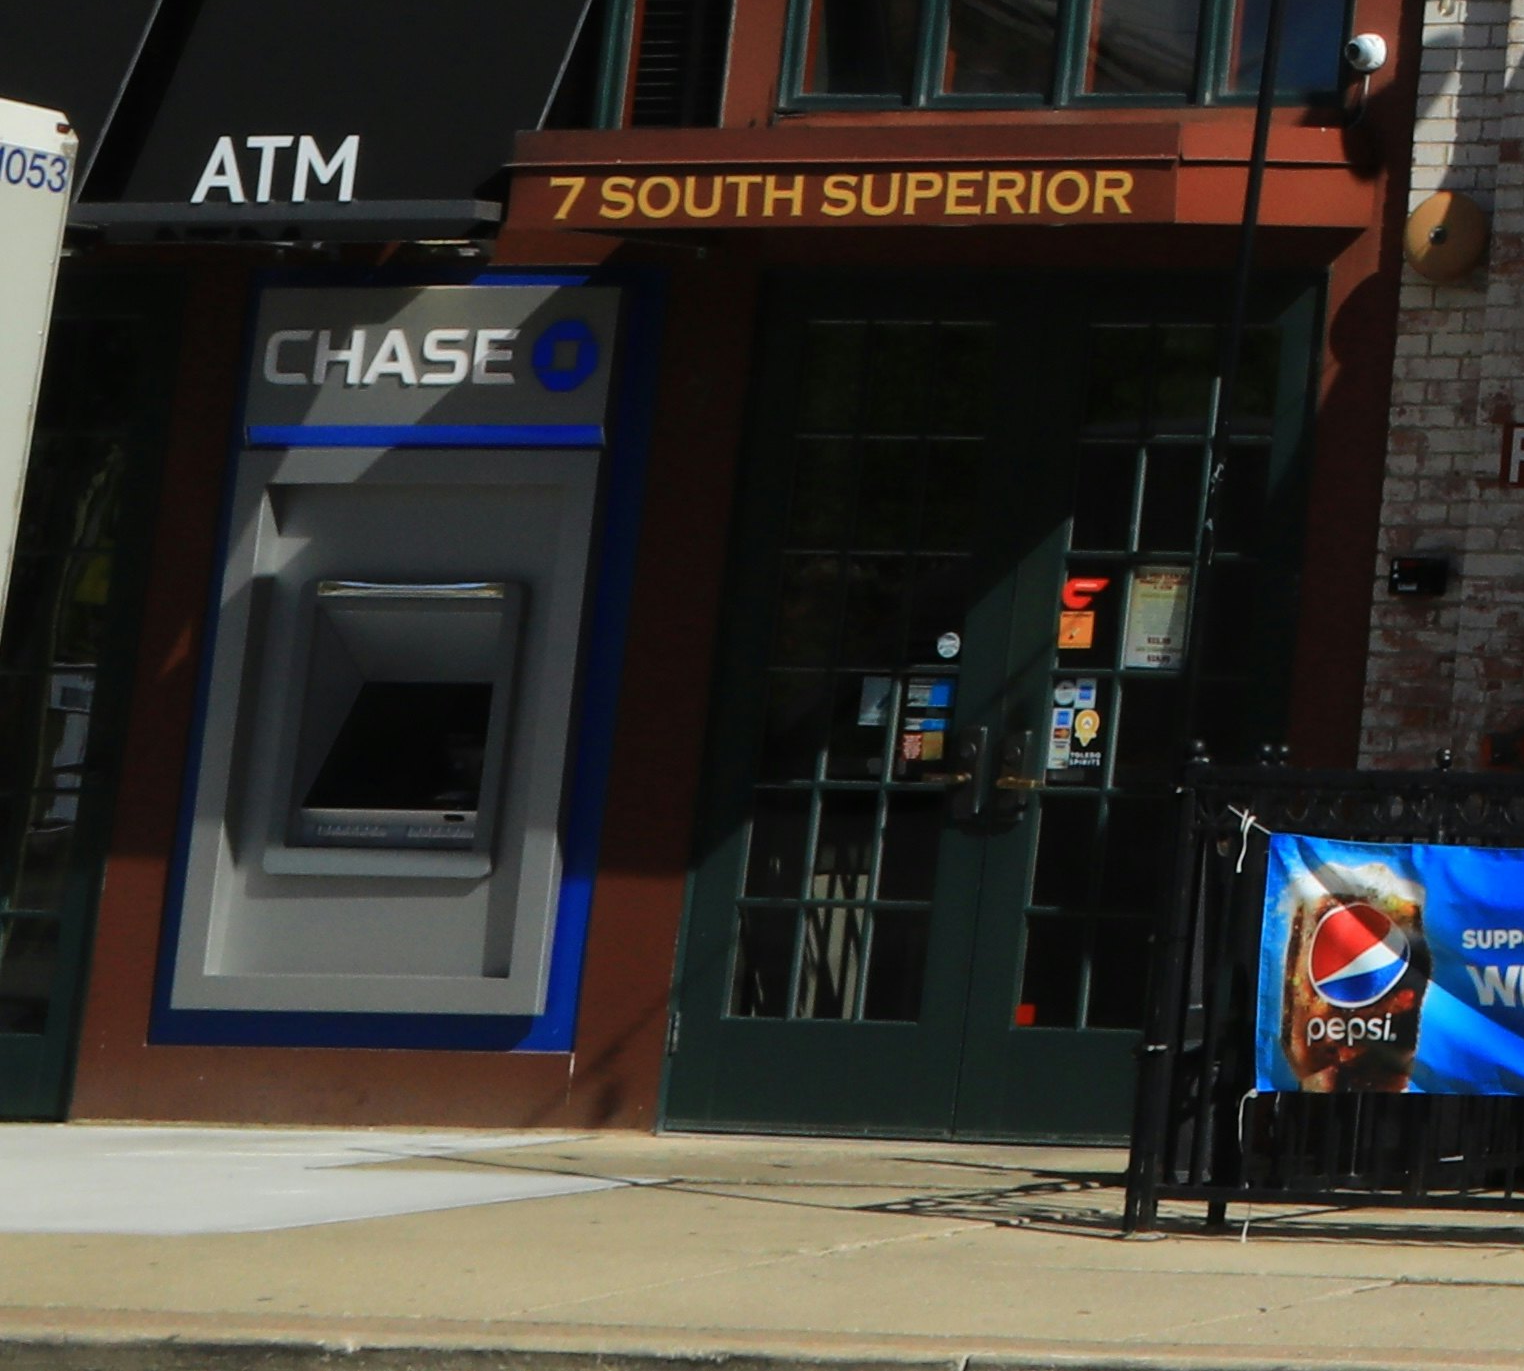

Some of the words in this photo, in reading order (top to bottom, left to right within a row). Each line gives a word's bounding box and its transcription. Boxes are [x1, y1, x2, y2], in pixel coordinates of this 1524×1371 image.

[190, 134, 361, 203] ATM
[549, 176, 586, 220] 7
[600, 175, 804, 220] SOUTH
[820, 169, 1134, 218] SUPERIOR
[263, 328, 522, 386] CHASE
[1306, 1011, 1392, 1046] pepsi
